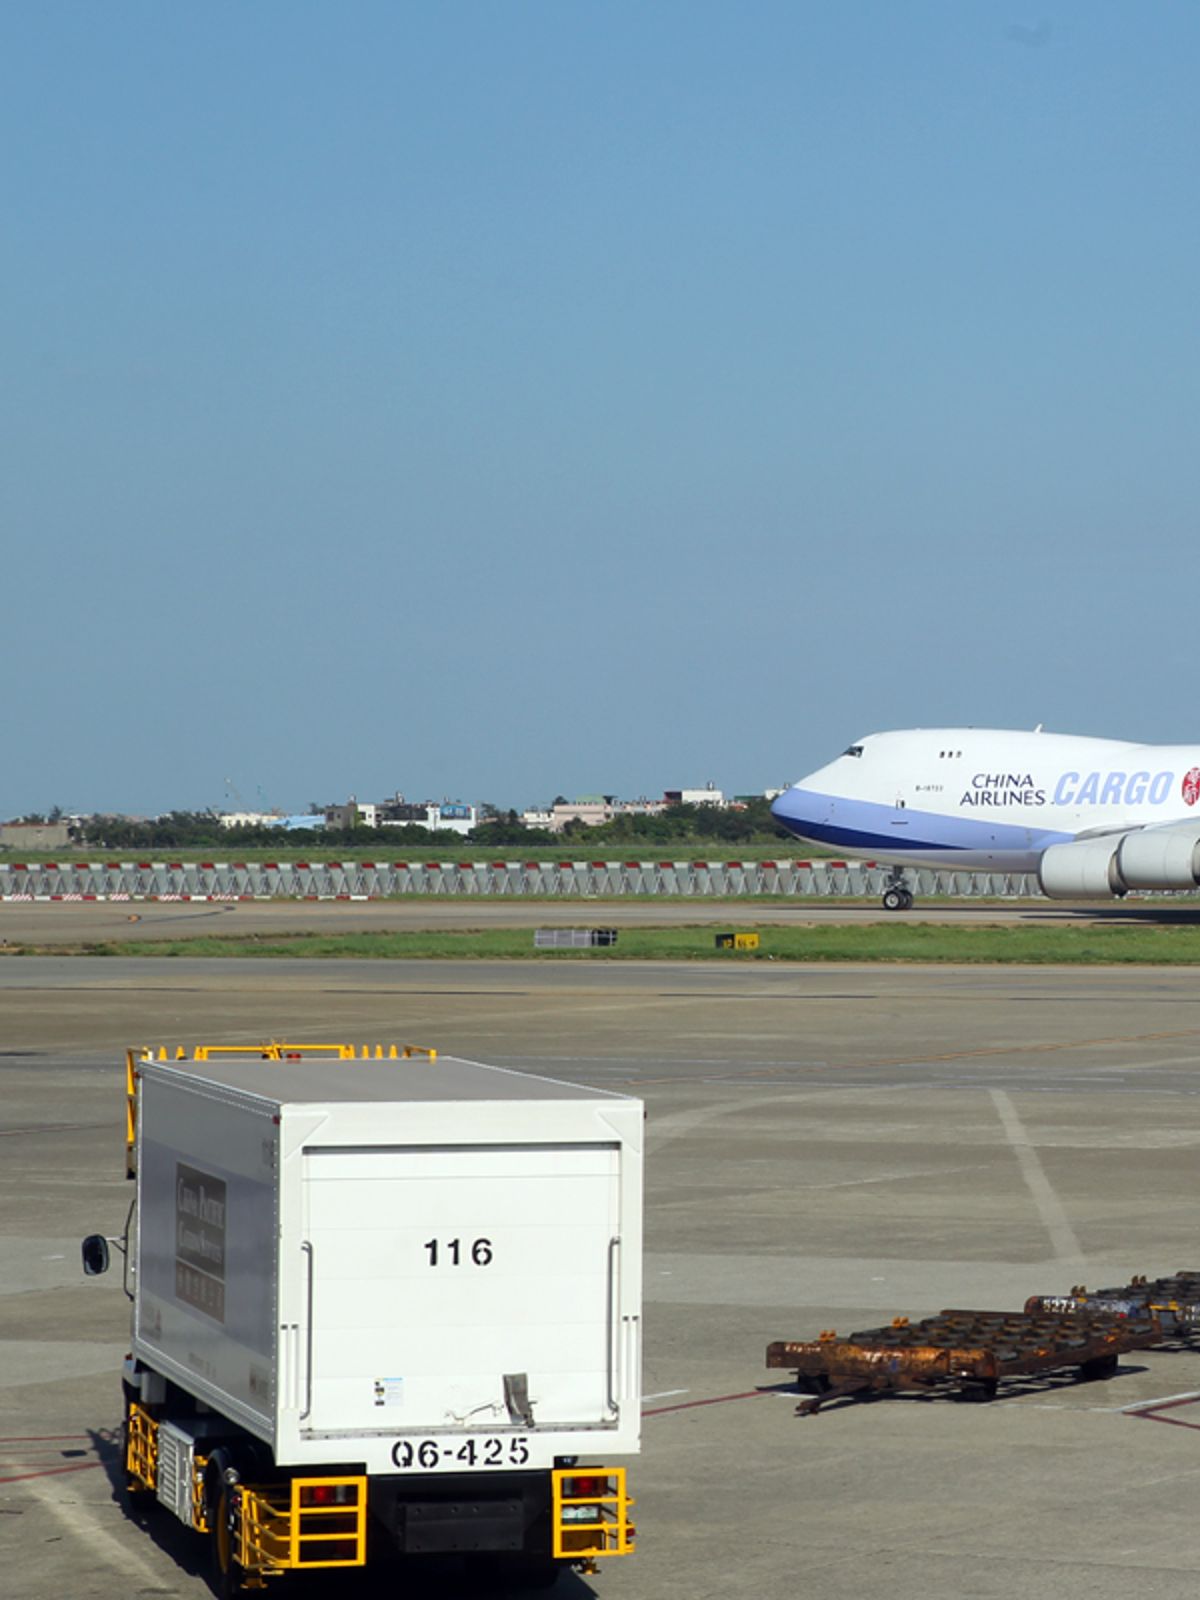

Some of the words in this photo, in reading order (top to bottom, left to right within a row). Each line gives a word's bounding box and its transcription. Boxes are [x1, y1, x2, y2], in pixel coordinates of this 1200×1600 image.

[971, 773, 1034, 788] CHINA
[1053, 771, 1175, 806] CARGO
[959, 789, 1046, 806] AIRLINES
[424, 1238, 493, 1266] 116
[391, 1437, 529, 1469] Q6-425
